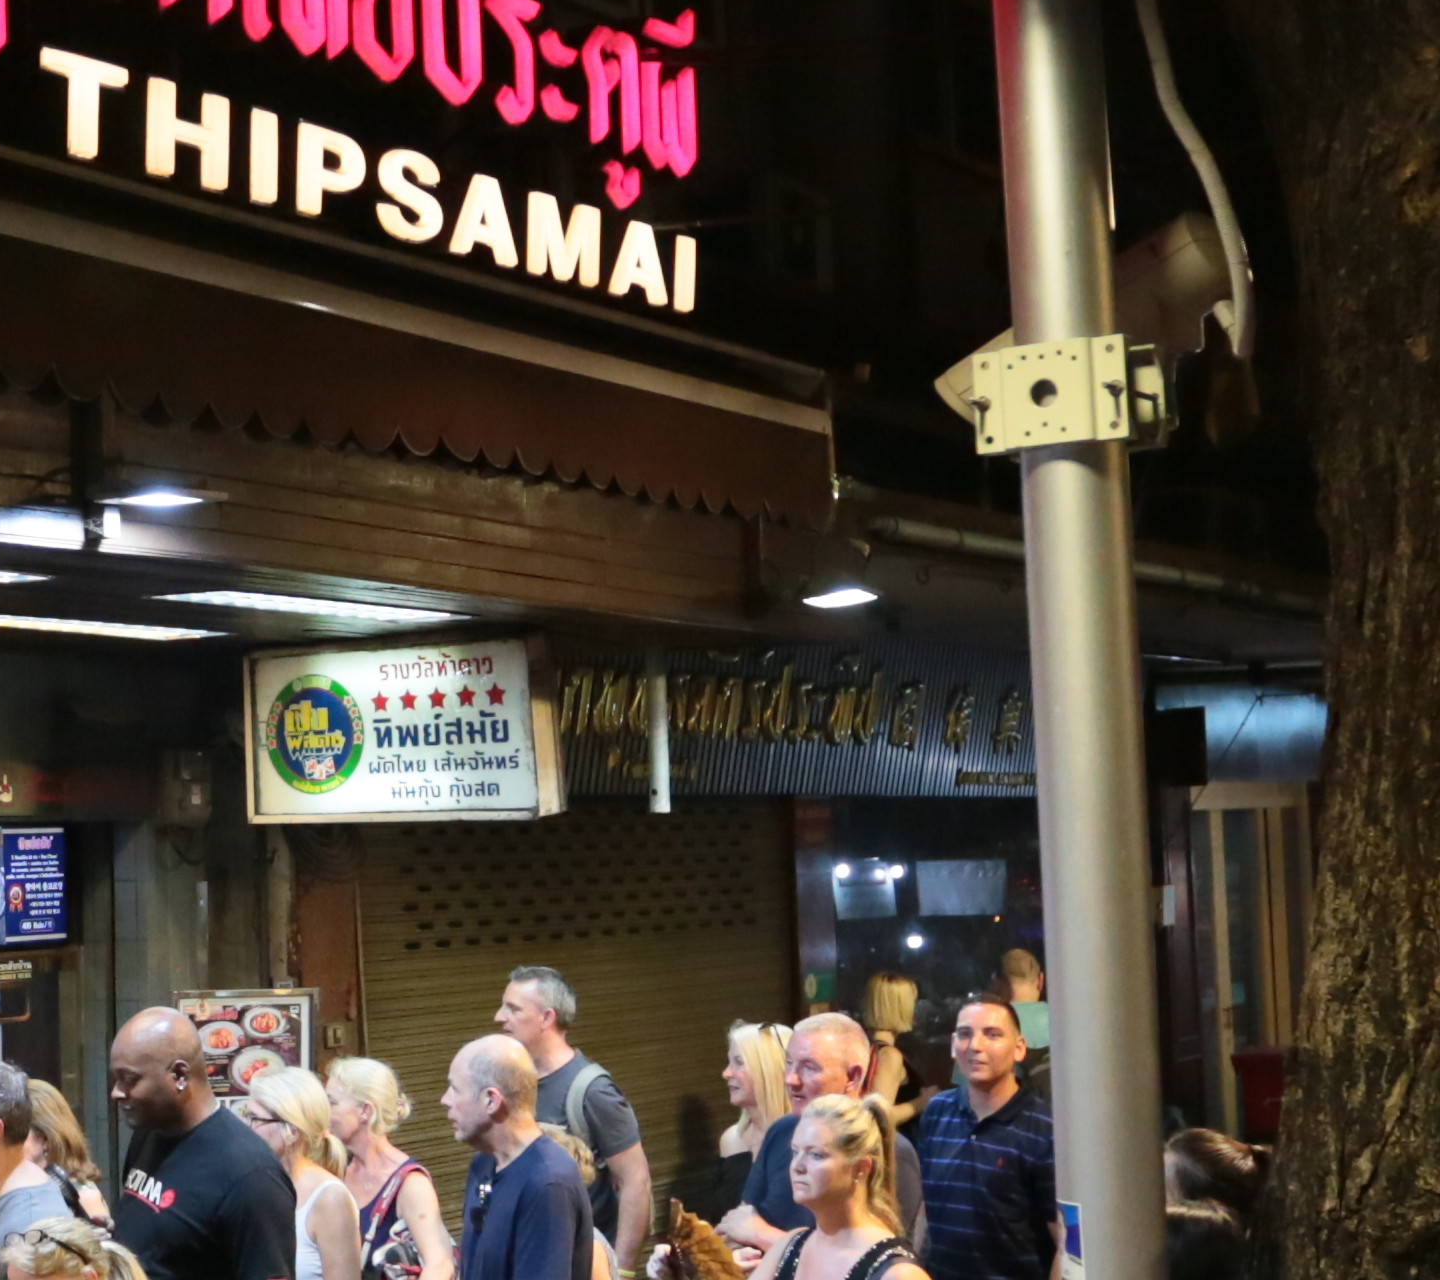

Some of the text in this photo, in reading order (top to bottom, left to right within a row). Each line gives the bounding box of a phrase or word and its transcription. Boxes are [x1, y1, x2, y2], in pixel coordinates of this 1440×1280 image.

[39, 46, 697, 313] THIPSAMAI
[379, 652, 494, 681] รางวัลห้าดาว
[372, 710, 510, 748] ทิพย์สมัย
[368, 748, 521, 774] ผัดไทย เส้นจันทร์
[391, 777, 501, 806] มันกุ้ง กุ้งสด
